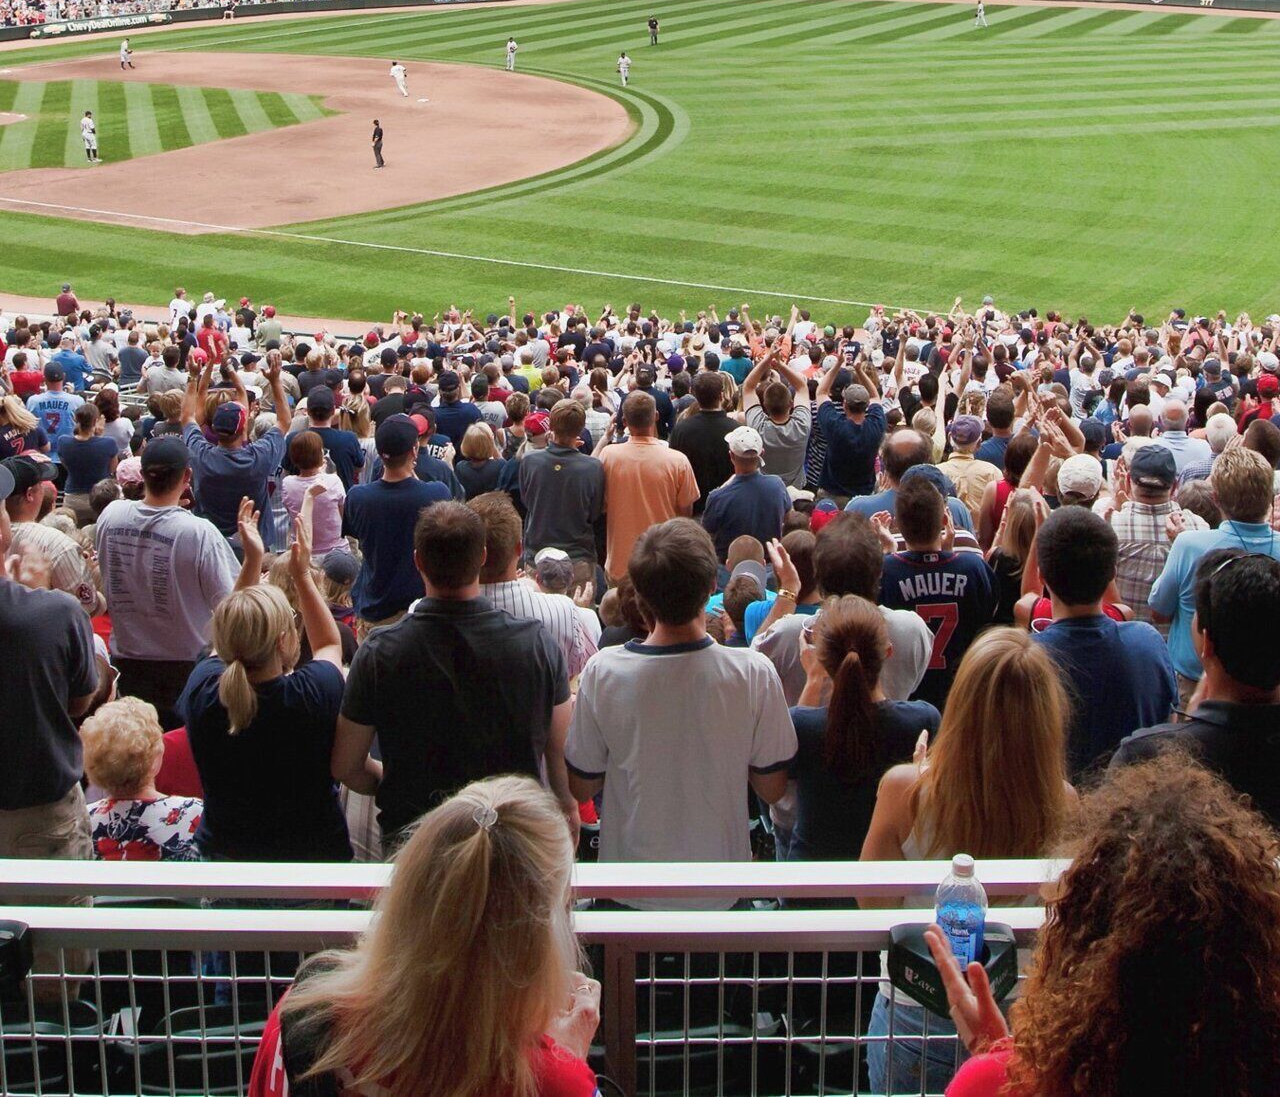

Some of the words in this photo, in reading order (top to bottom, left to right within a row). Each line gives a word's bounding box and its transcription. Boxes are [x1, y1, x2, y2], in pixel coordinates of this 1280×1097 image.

[39, 401, 69, 412] MAUER
[45, 413, 61, 434] 7
[899, 573, 968, 602] MAUER
[915, 602, 959, 670] 7
